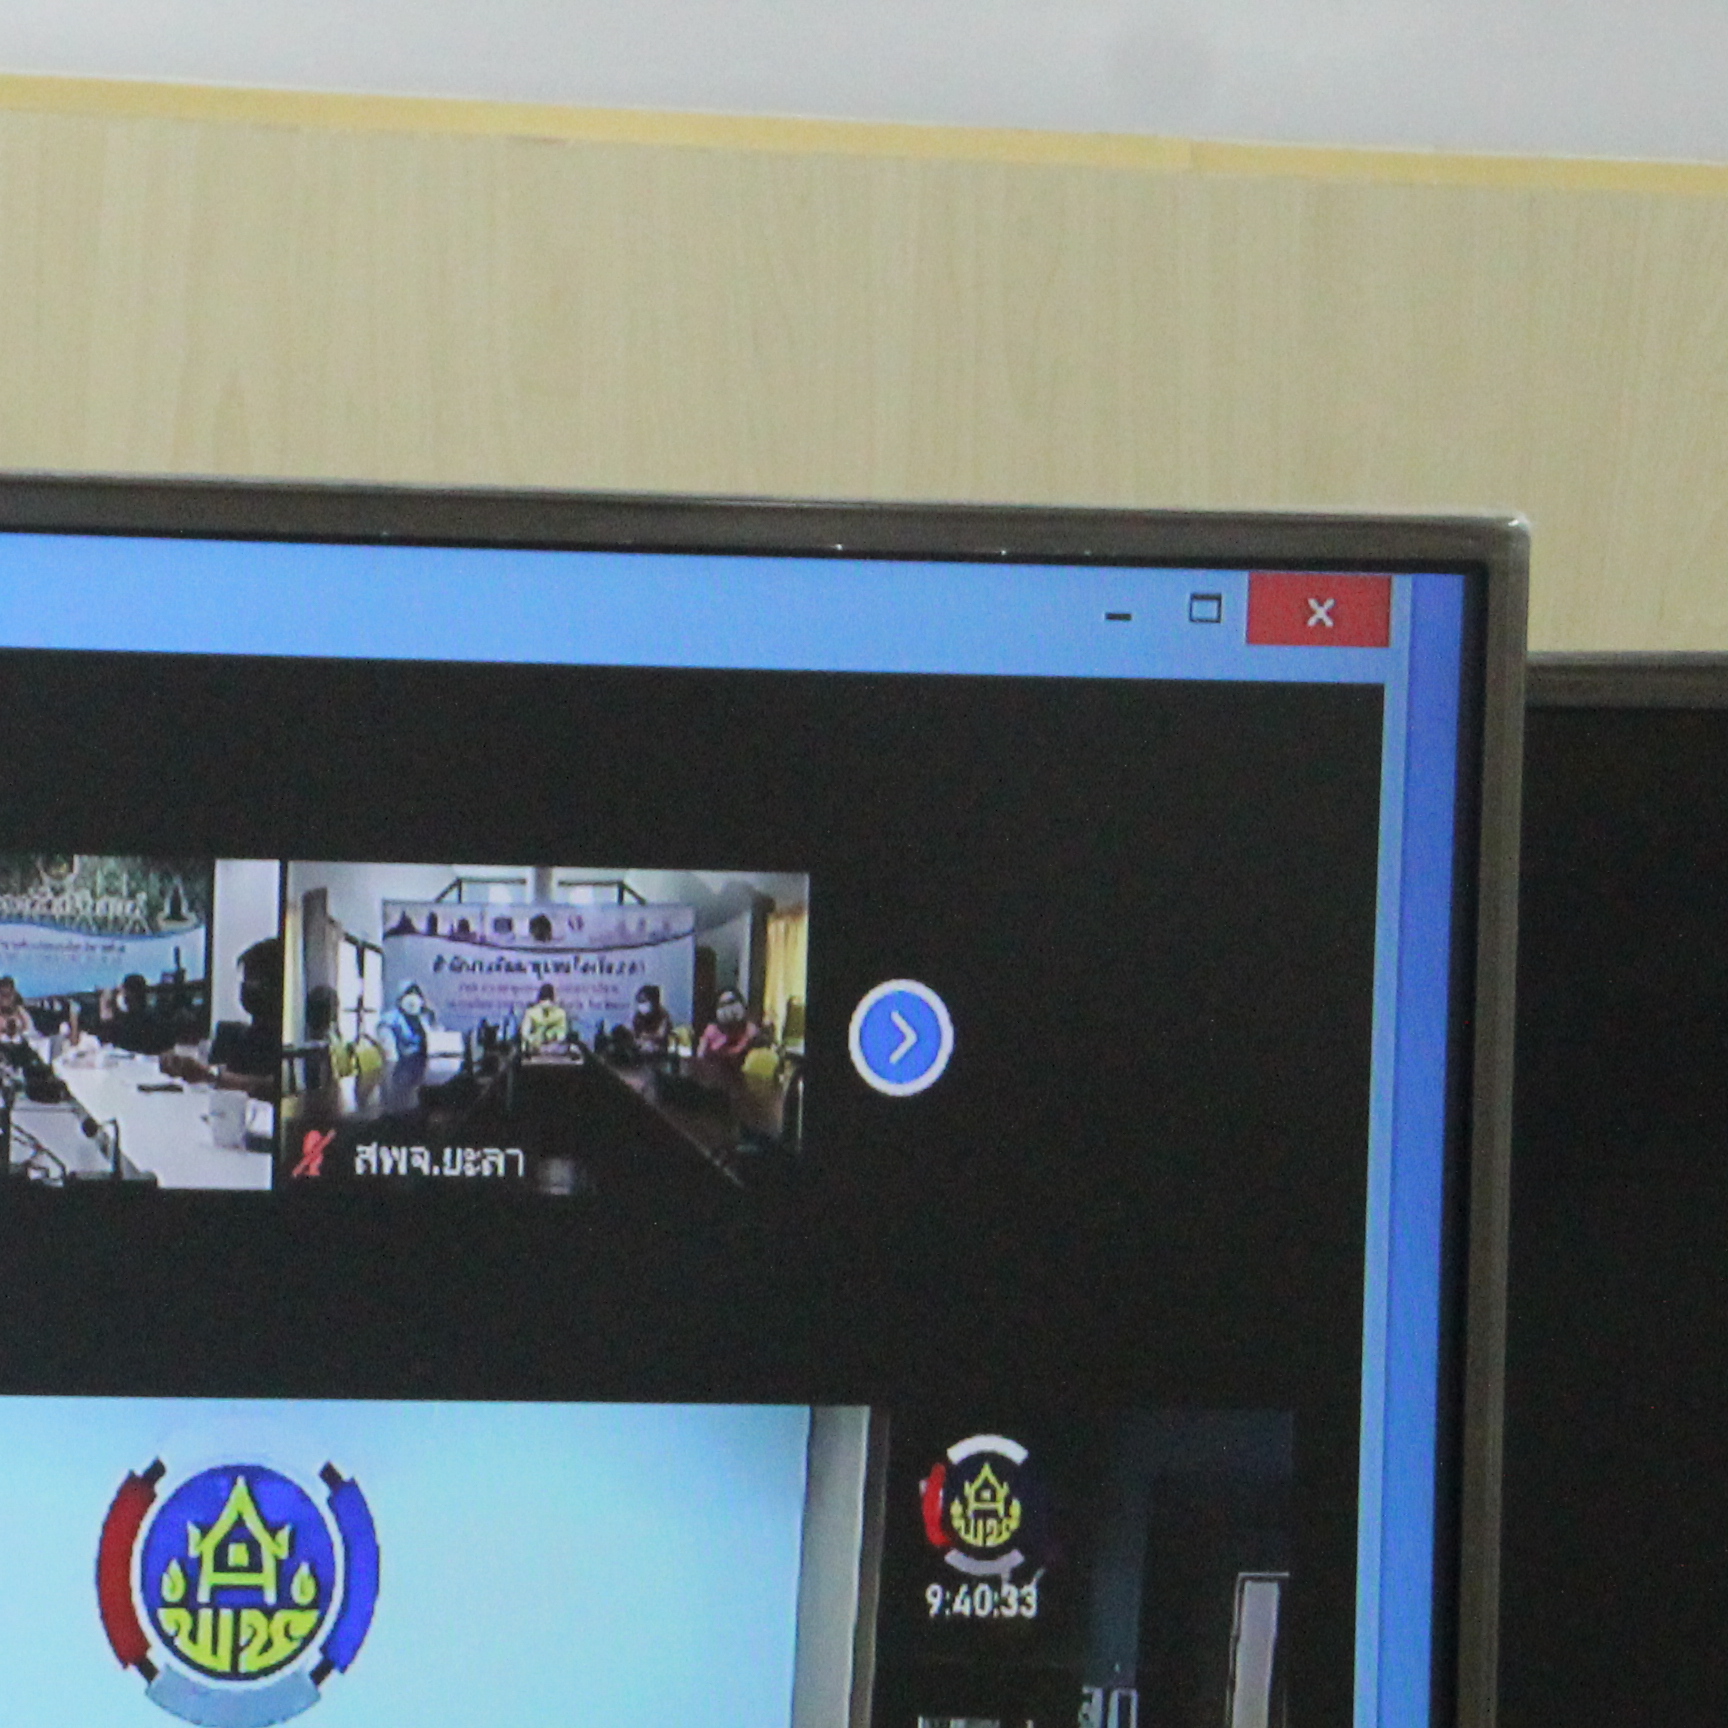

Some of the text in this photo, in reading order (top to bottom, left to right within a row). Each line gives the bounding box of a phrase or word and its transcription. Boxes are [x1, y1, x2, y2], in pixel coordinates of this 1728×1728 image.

[354, 1142, 524, 1178] สพจ.ยะลา
[925, 1583, 1038, 1619] 9:40:33
